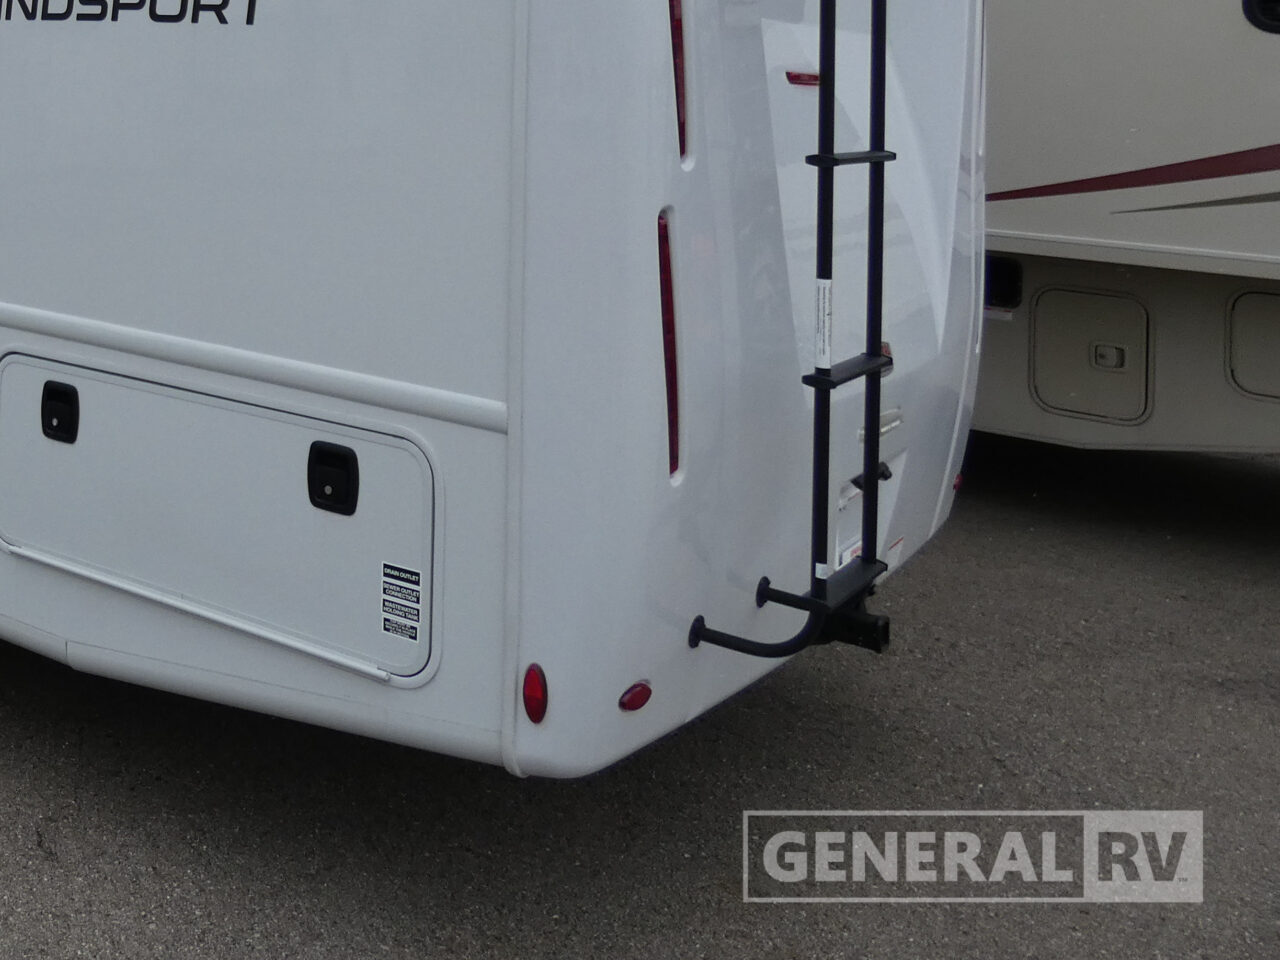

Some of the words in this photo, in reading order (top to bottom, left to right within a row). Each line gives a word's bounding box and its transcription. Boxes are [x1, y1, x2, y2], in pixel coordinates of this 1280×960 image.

[384, 568, 399, 577] DRAIN
[400, 571, 419, 582] OUTLET
[385, 589, 418, 602] CONNECTION
[401, 587, 420, 597] OUTLET
[383, 606, 405, 617] HOLDING
[406, 611, 419, 621] TANK
